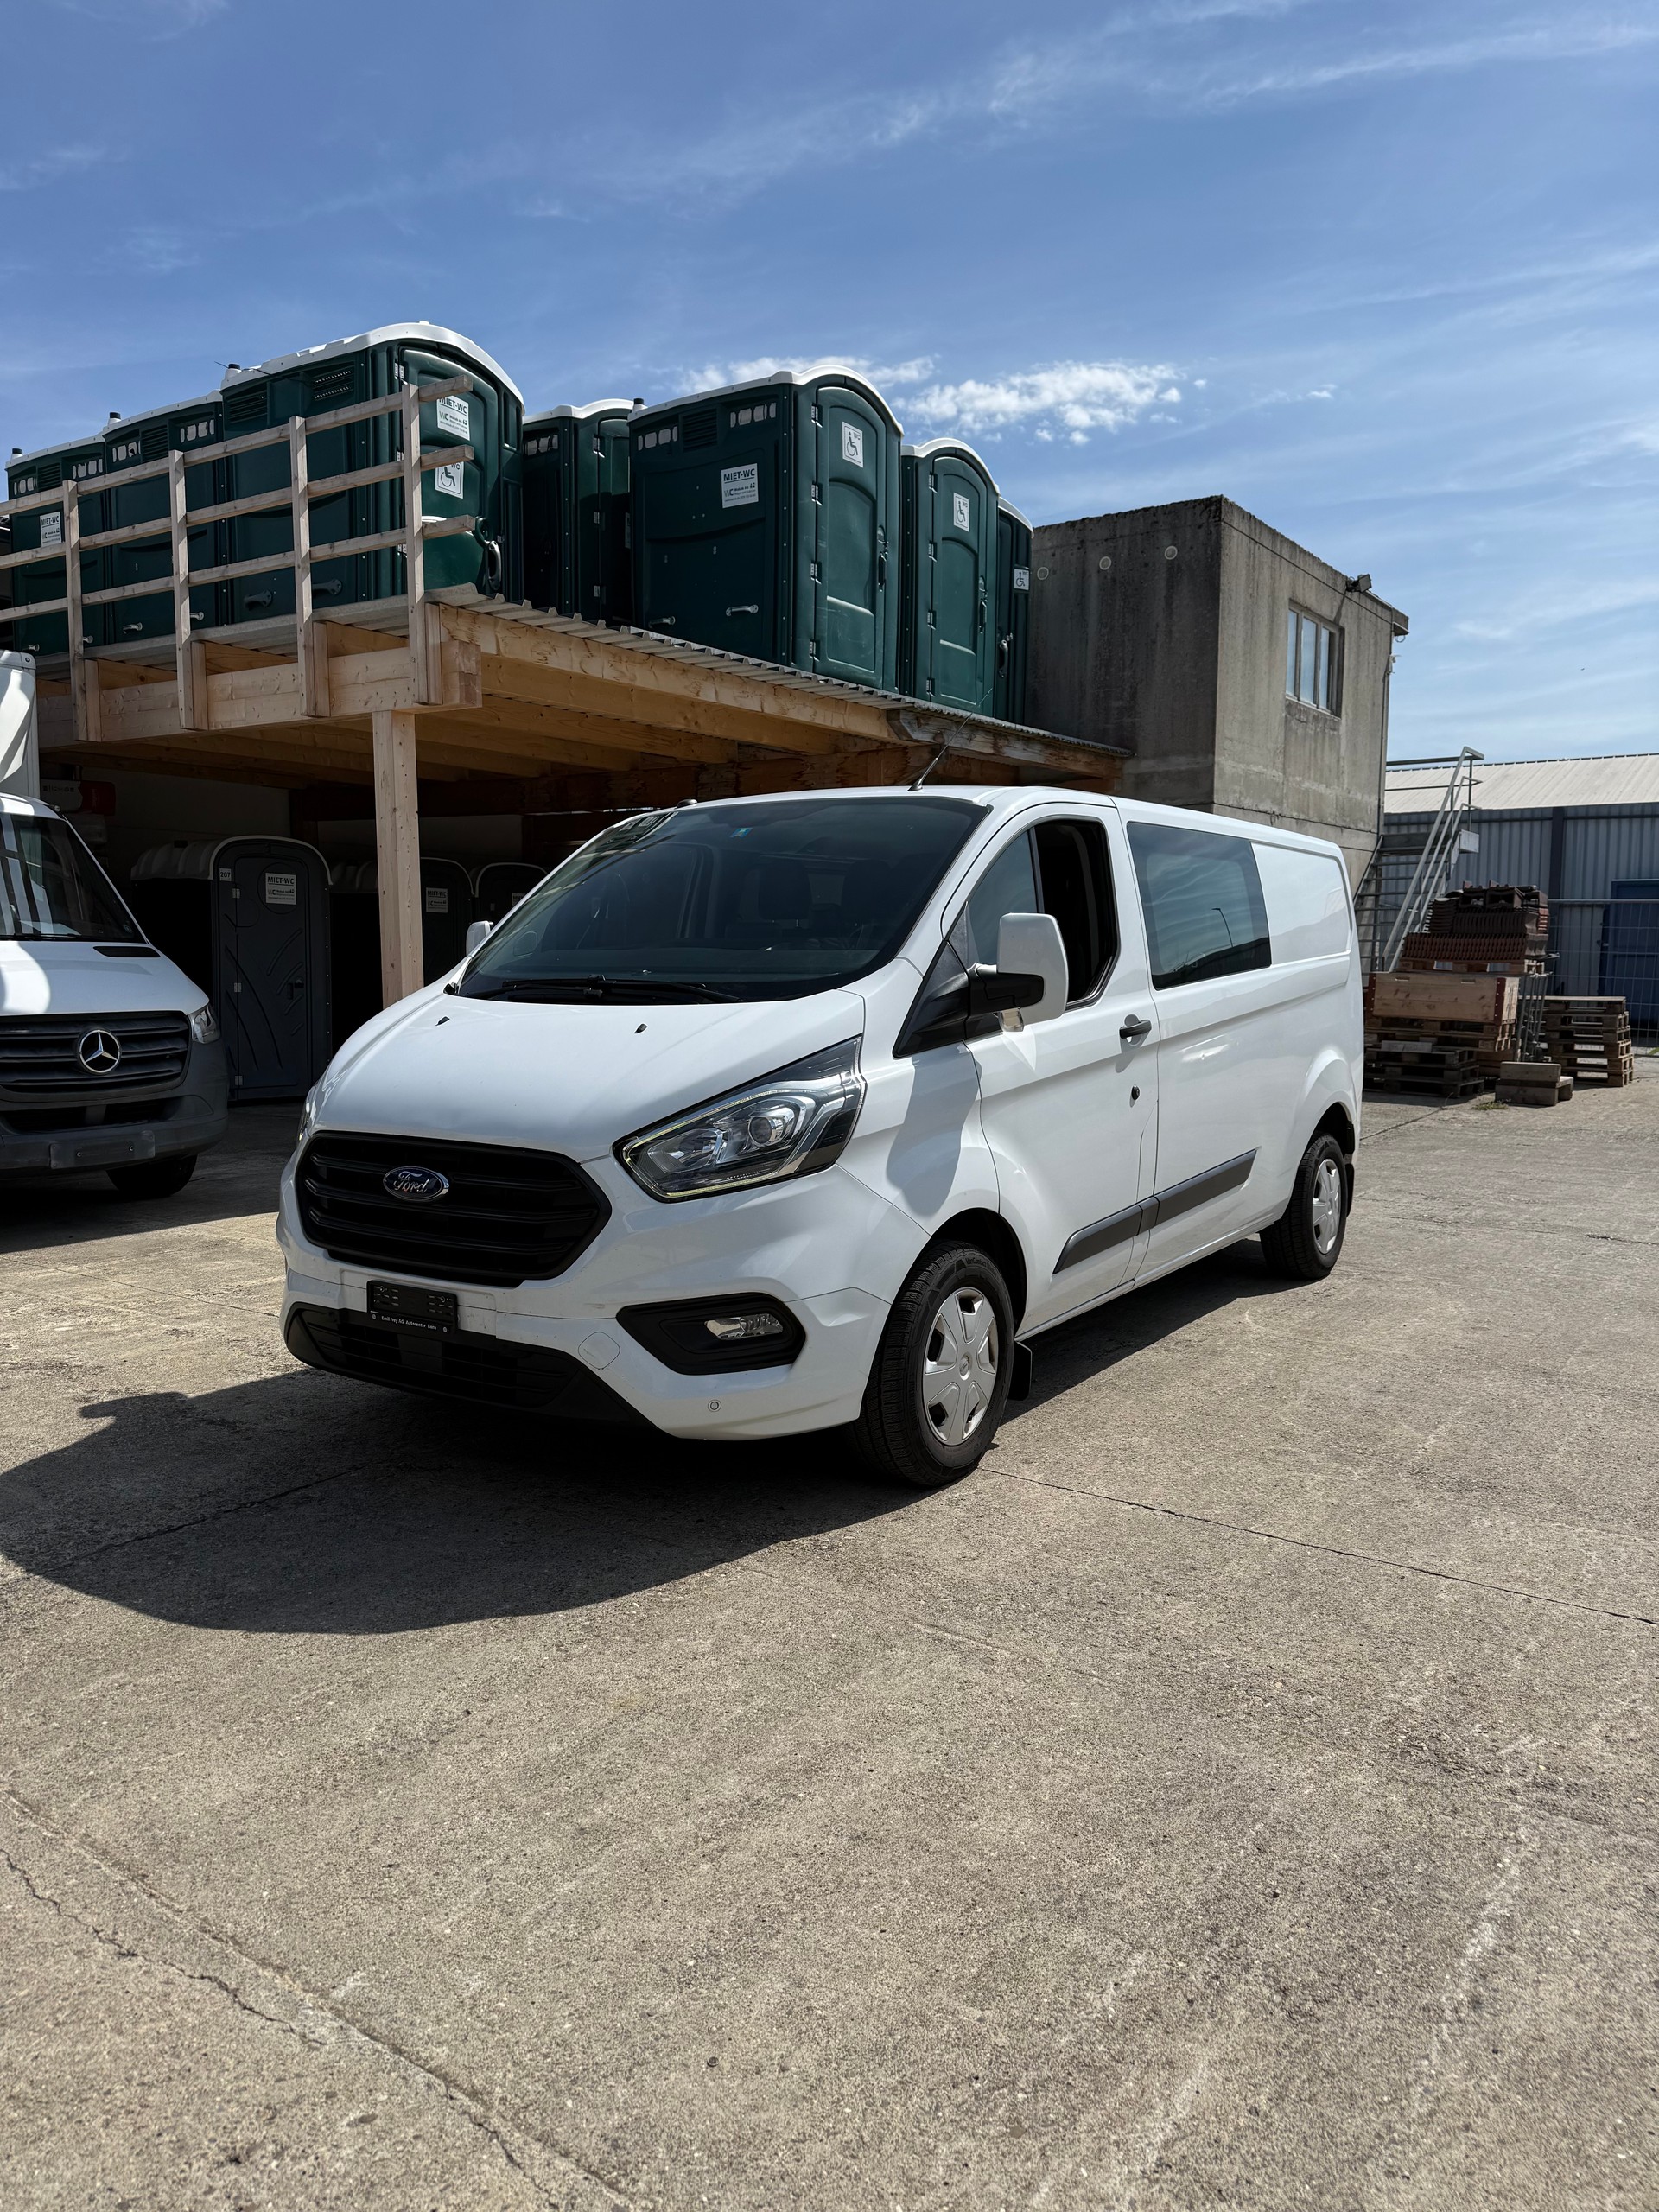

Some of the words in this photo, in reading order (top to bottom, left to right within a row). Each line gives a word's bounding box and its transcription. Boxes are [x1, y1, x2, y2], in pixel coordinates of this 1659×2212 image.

[723, 468, 755, 482] MIET-WC
[41, 515, 60, 526] MIET-WC
[268, 876, 295, 885] MIET-WC
[393, 1170, 430, 1193] Ford
